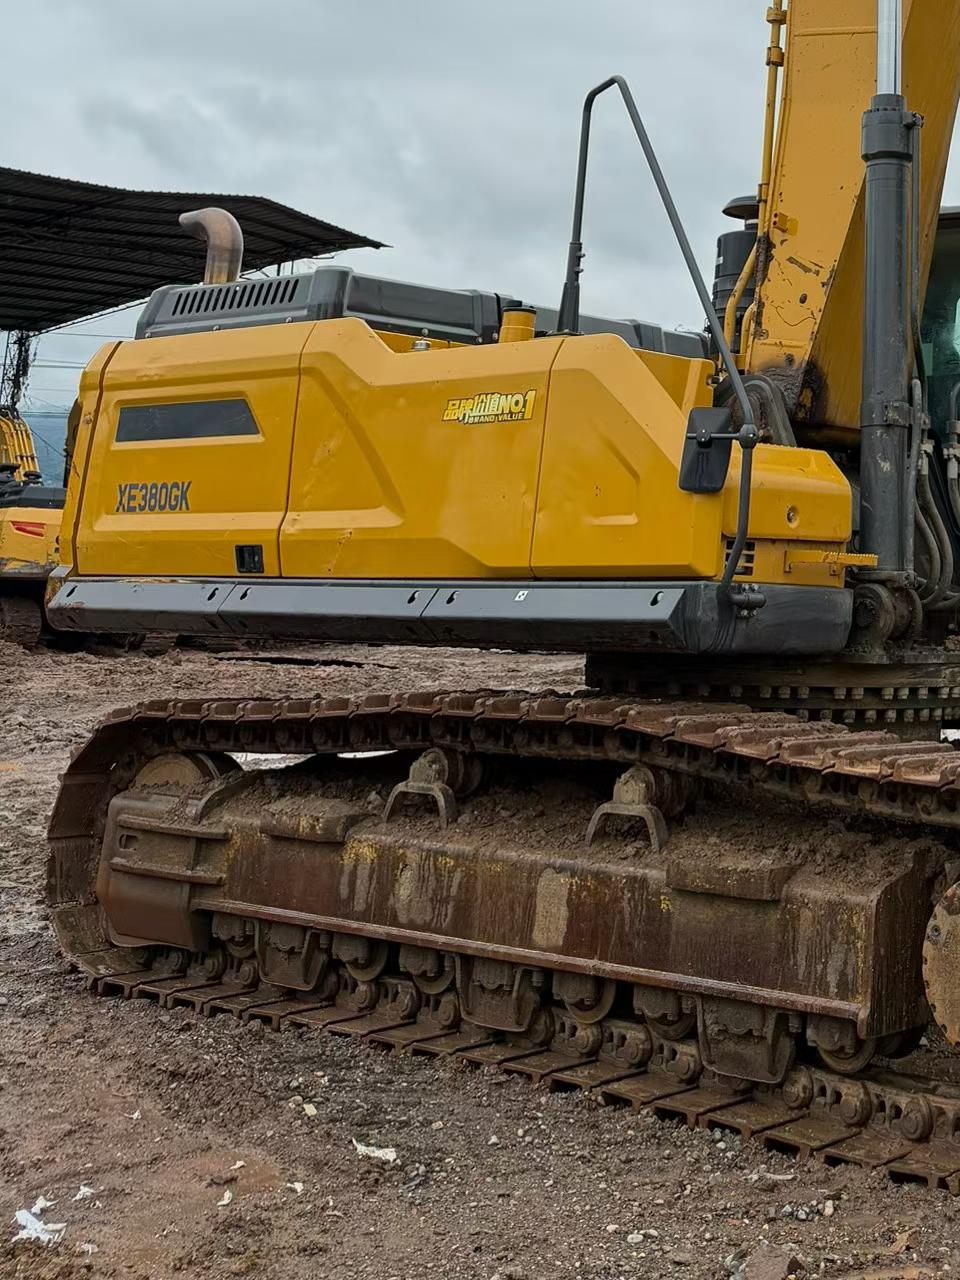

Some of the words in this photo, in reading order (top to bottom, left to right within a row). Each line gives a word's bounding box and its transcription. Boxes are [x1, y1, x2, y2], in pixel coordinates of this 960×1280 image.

[468, 414, 495, 424] BRAND
[498, 412, 524, 422] VALUE
[115, 480, 193, 513] XE380GK
